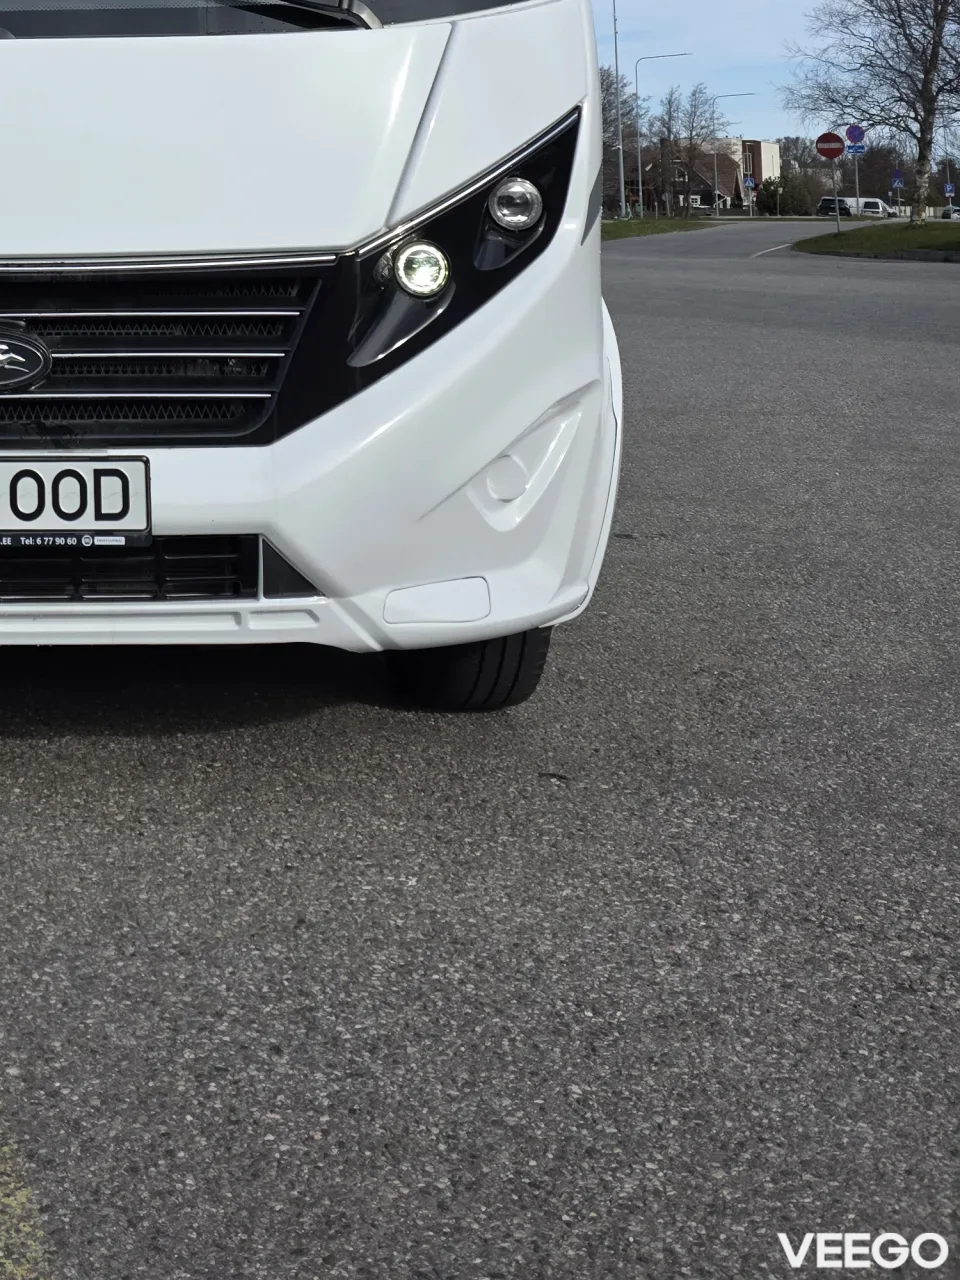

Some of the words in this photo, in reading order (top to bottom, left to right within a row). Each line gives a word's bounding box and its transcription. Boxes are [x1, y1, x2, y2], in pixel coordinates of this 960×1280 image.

[9, 468, 130, 522] OOD
[20, 537, 35, 546] Tel:
[36, 537, 42, 546] 6
[43, 537, 54, 546] 77
[55, 537, 65, 546] 90
[66, 537, 77, 546] 60
